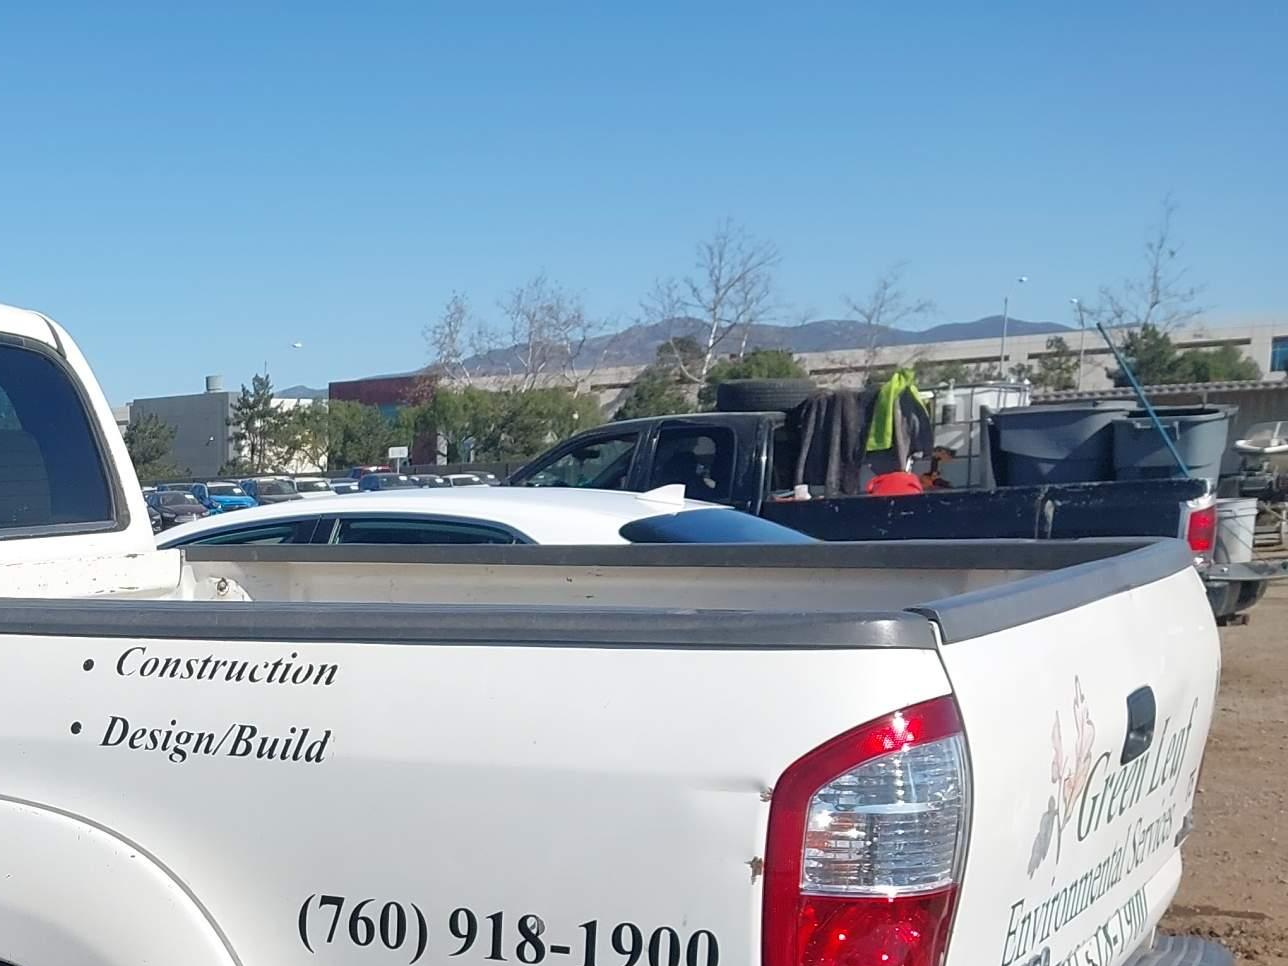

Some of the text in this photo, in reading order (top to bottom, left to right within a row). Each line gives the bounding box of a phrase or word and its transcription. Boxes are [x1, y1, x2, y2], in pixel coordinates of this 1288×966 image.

[116, 646, 338, 686] Construction
[99, 715, 331, 764] Design/Build
[1077, 750, 1150, 842] Green
[1146, 697, 1199, 797] Leaf
[298, 893, 428, 965] (760)
